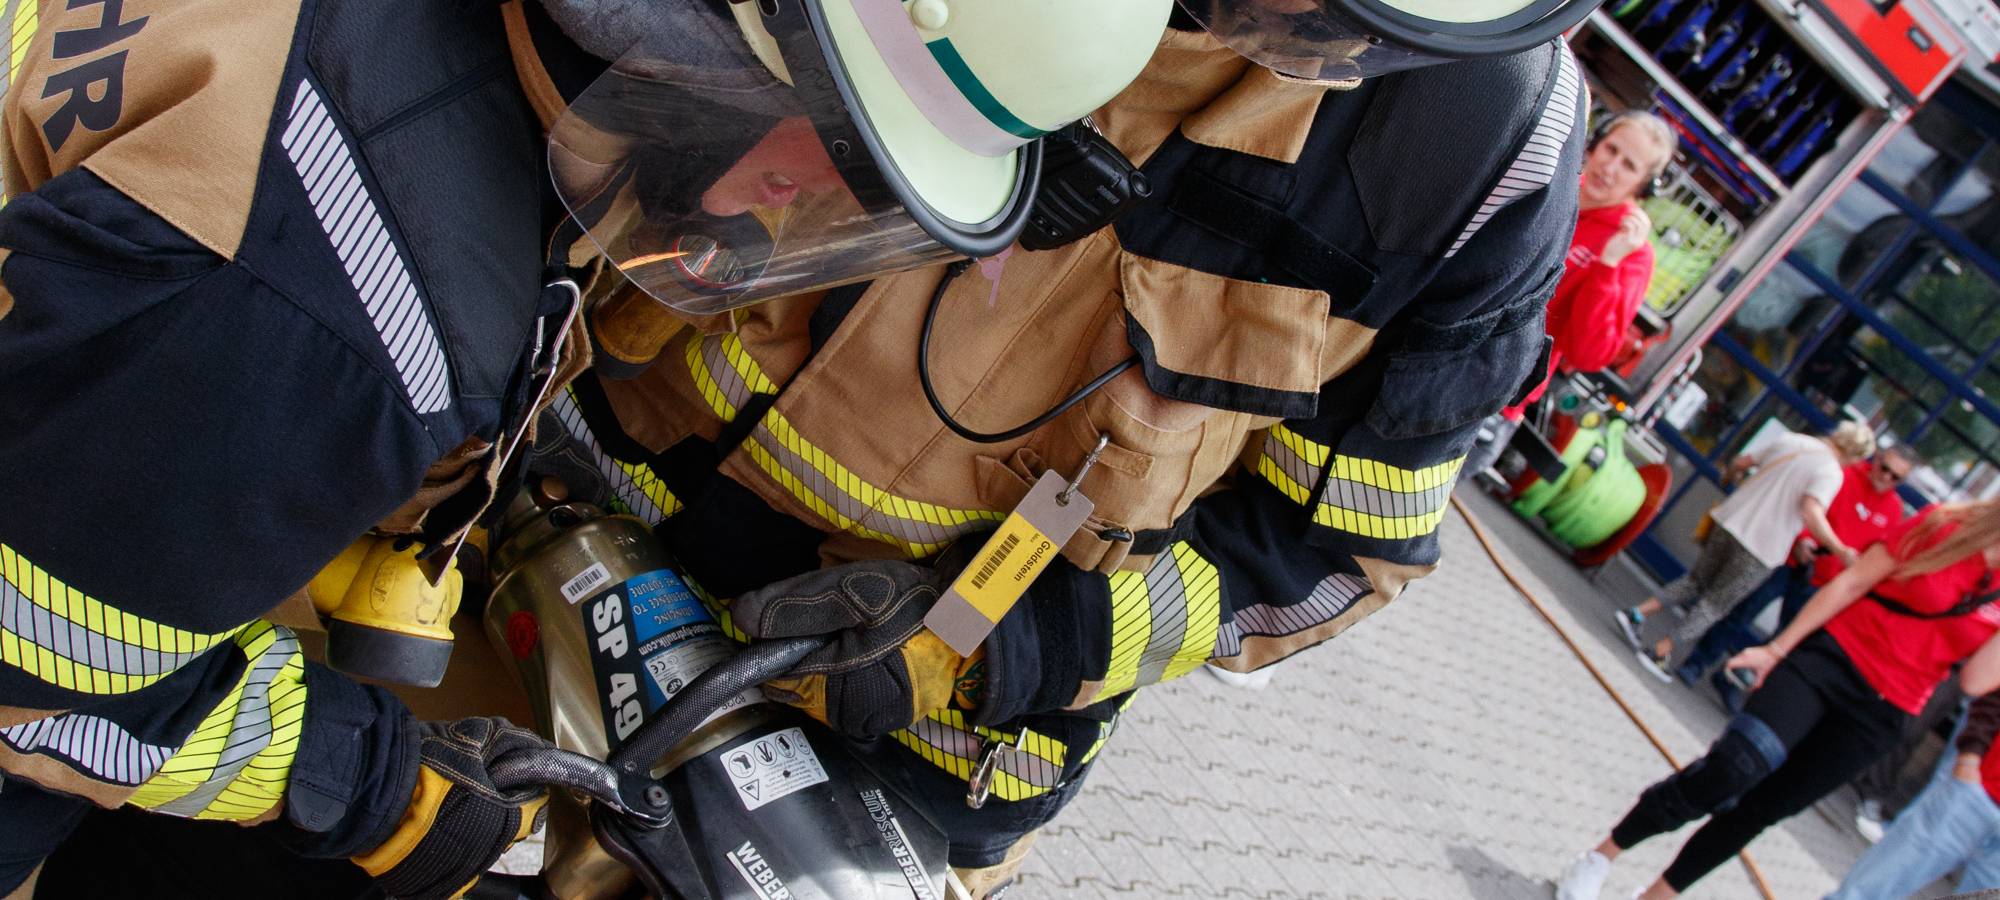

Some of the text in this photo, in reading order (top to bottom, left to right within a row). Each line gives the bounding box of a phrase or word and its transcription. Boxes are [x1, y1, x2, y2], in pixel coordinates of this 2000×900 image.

[1013, 540, 1051, 582] Goldstein
[592, 593, 629, 660] SP
[632, 603, 649, 616] TO
[609, 673, 644, 742] 49
[874, 788, 893, 816] SYSTEMS
[737, 840, 794, 900] WEBER
